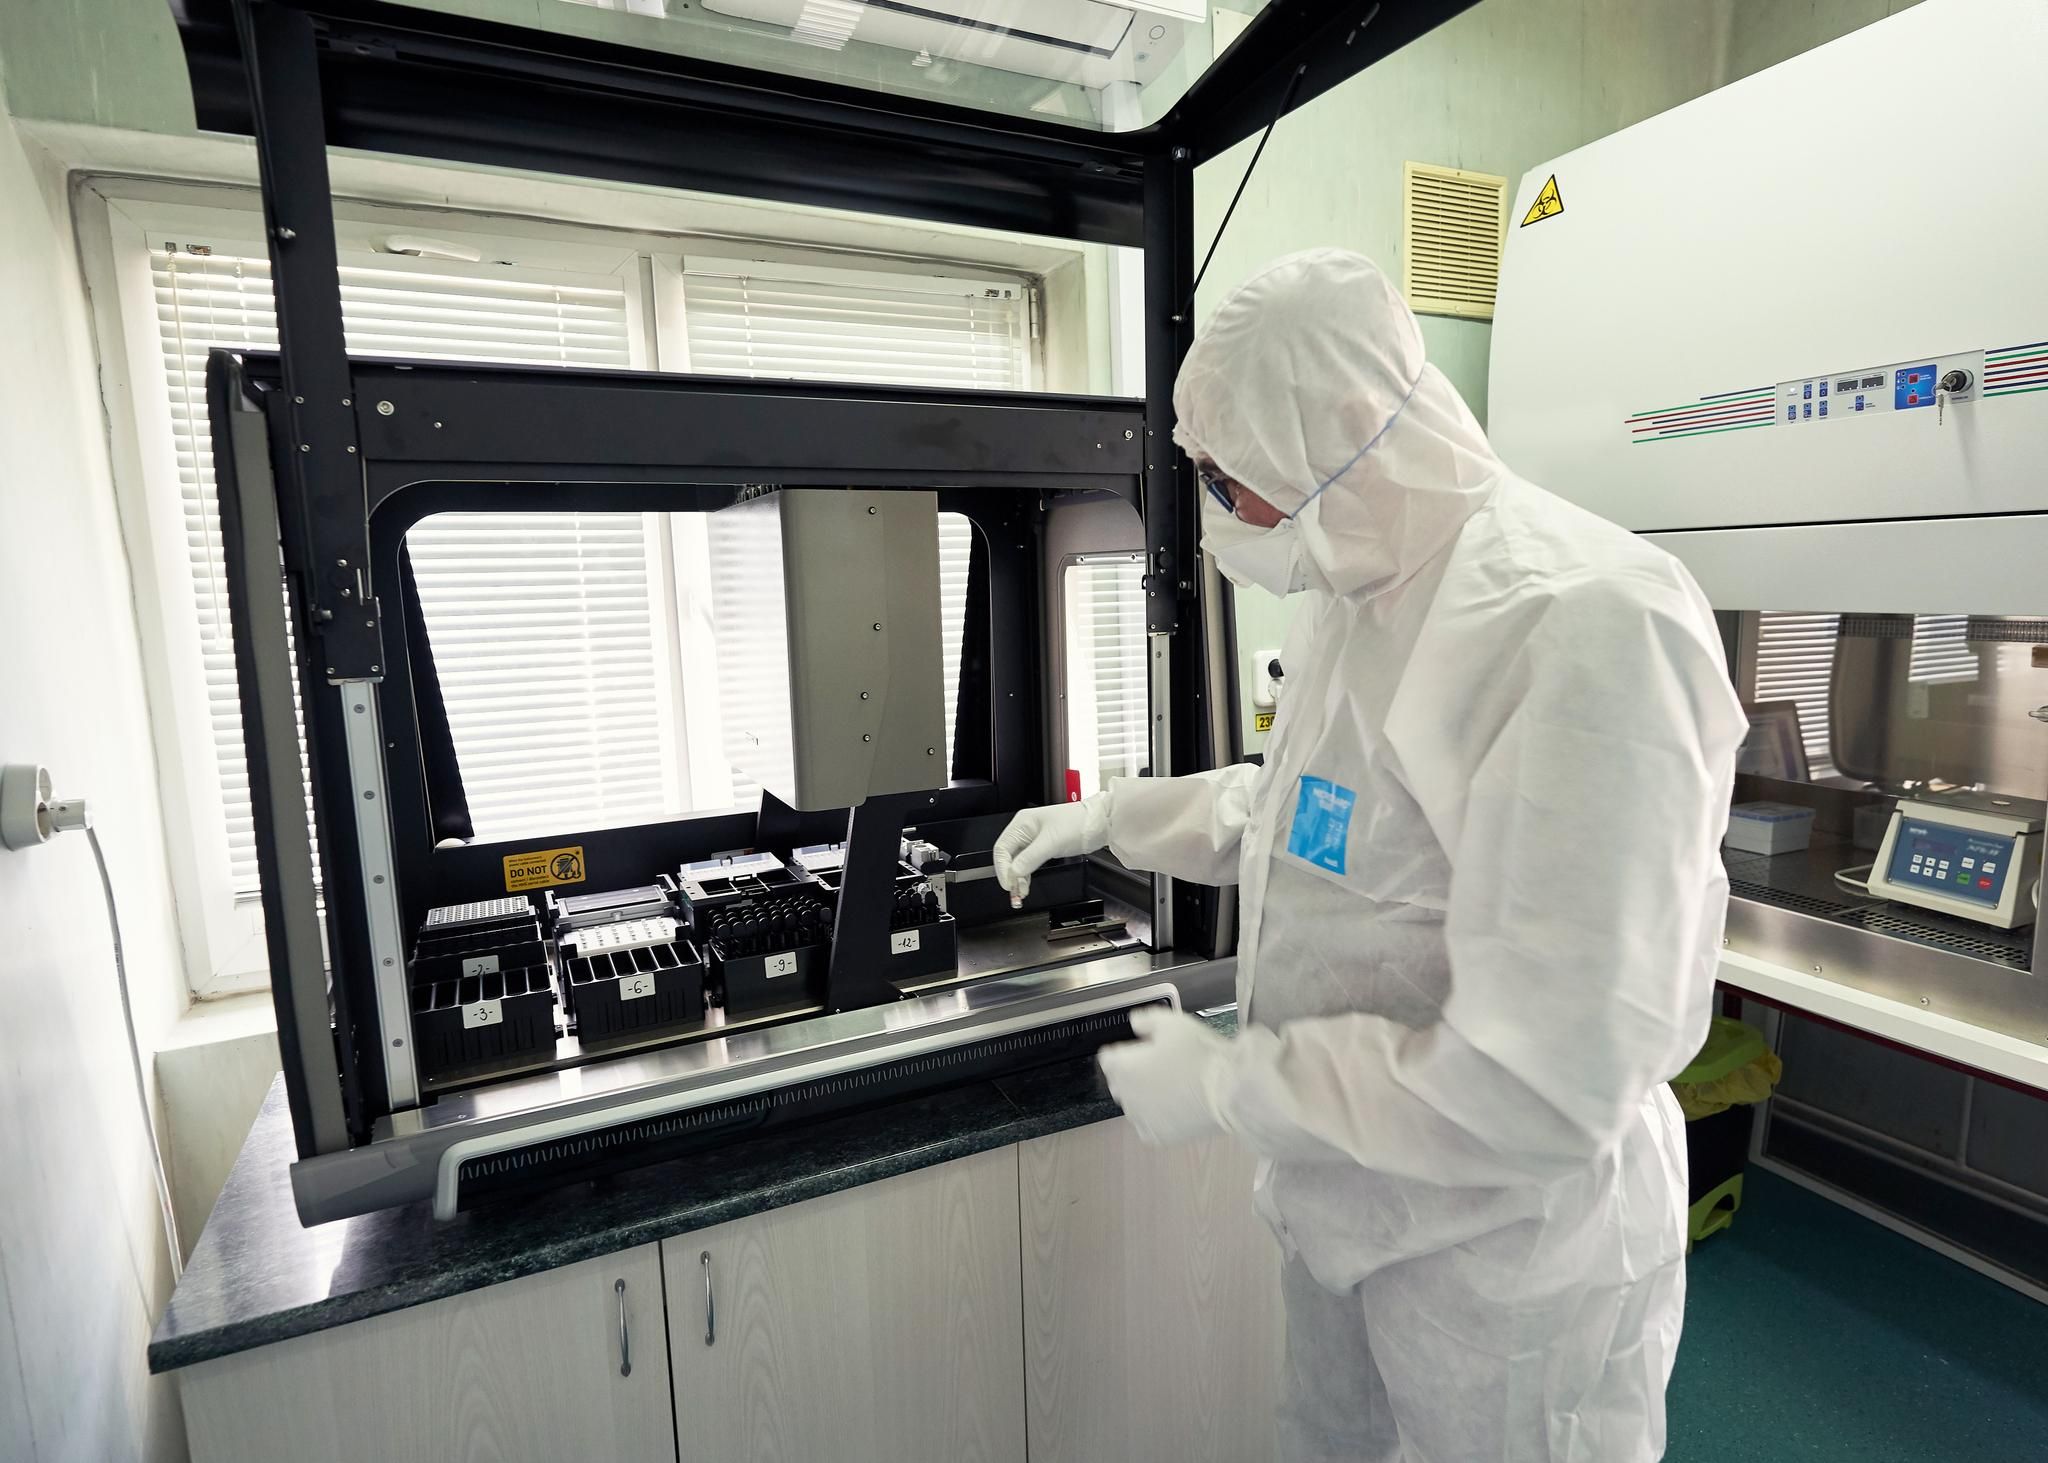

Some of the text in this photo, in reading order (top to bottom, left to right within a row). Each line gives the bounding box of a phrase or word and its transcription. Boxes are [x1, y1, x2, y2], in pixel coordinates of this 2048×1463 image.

[510, 865, 547, 878] DO NOT
[773, 959, 793, 972] -9-
[627, 980, 649, 994] -6-
[473, 1007, 494, 1021] -3-
